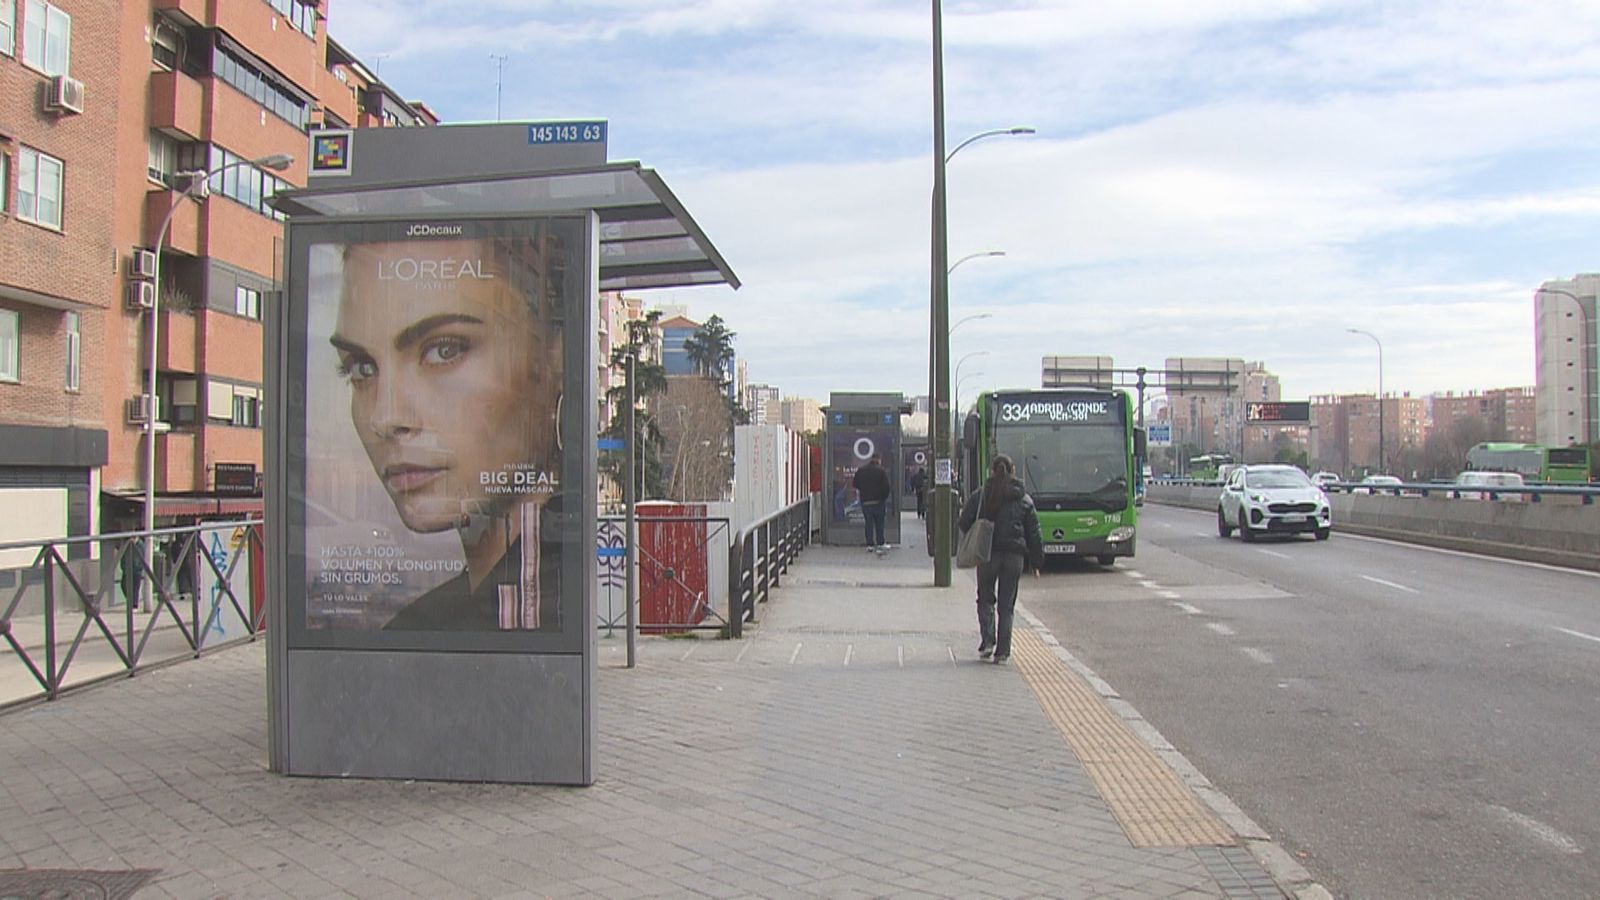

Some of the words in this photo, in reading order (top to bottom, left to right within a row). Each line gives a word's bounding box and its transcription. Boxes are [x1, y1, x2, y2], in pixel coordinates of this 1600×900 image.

[532, 126, 553, 142] 145
[555, 125, 577, 141] 143
[583, 124, 601, 141] 63
[406, 224, 463, 236] JCDecaux
[378, 256, 494, 280] L'ORÉAL
[1002, 402, 1030, 421] 334
[480, 471, 508, 485] BIG
[514, 471, 559, 485] DEAL
[484, 486, 512, 494] NUEVA
[514, 484, 554, 494] MÁSCARA
[321, 547, 361, 558] HASTA
[321, 559, 382, 571] VOLUMEN
[386, 559, 394, 571] Y
[320, 572, 341, 584] SIN
[344, 572, 402, 585] GRUMOS.
